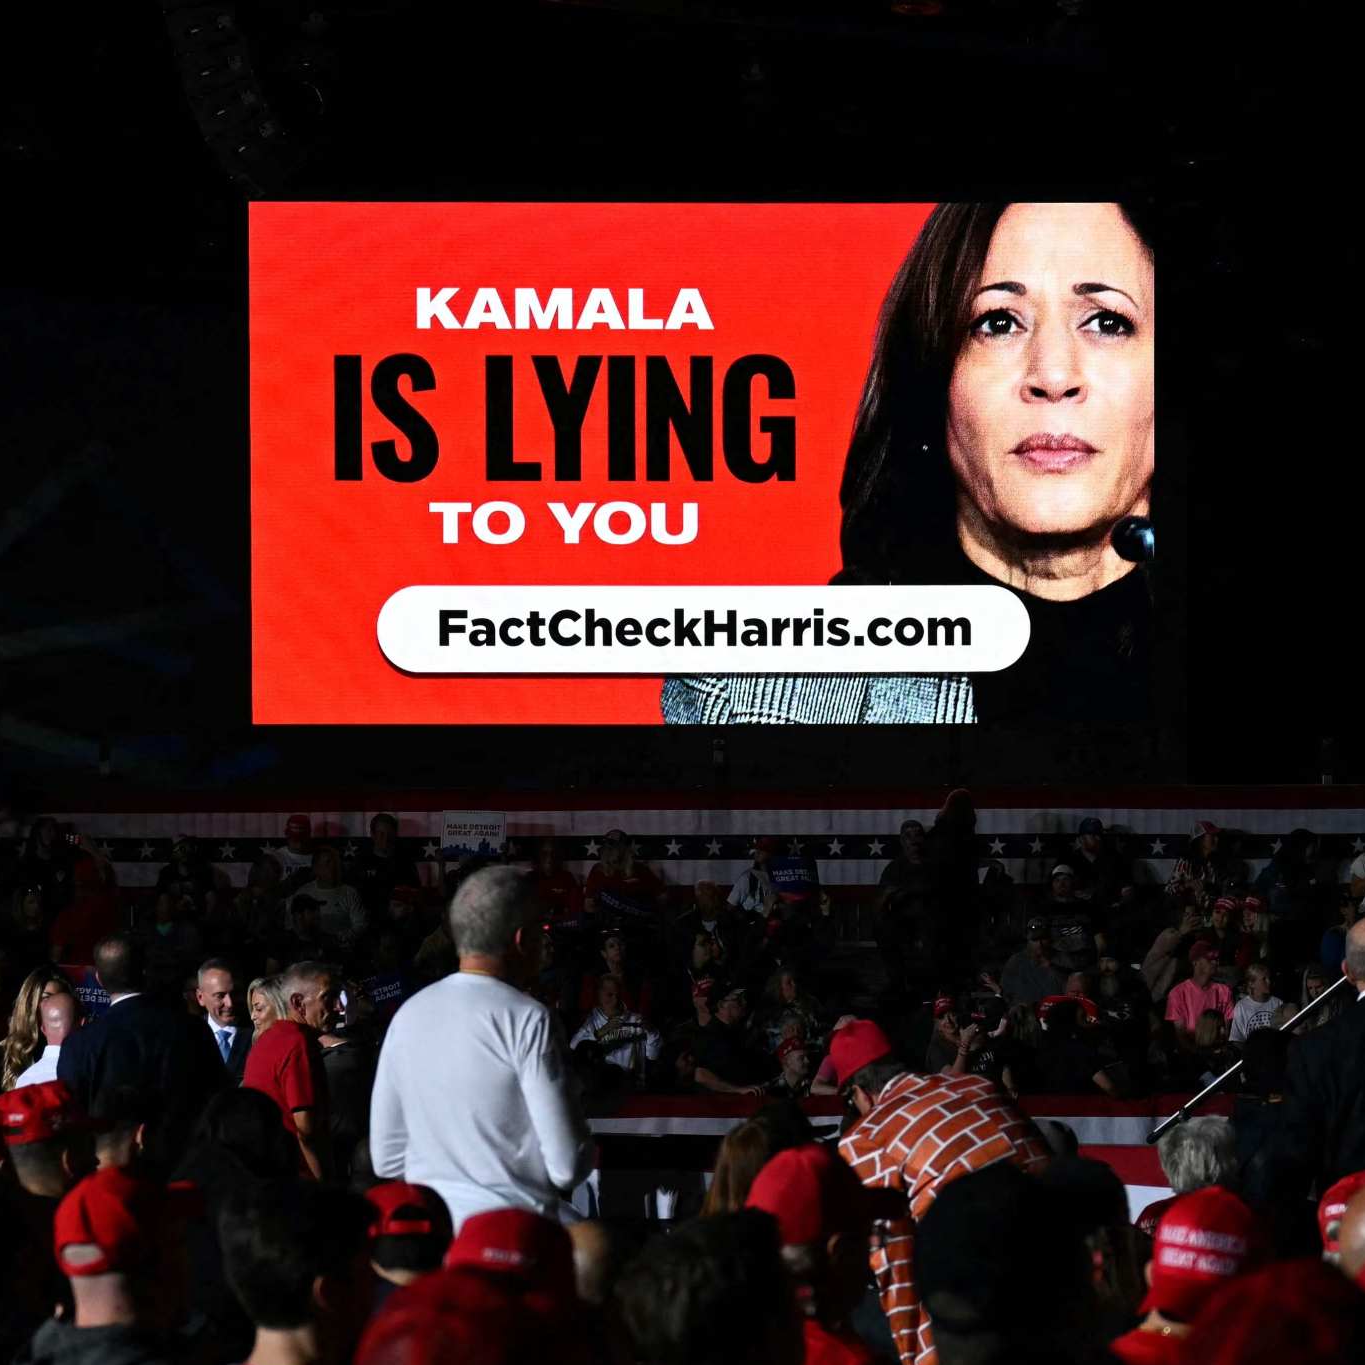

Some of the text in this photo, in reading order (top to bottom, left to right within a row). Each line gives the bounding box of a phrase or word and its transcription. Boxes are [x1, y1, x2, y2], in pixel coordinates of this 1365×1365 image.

[415, 288, 714, 330] KAMALA
[334, 353, 797, 483] IS LYING
[429, 501, 700, 545] TO YOU
[438, 607, 972, 650] FactCheckHarris.com
